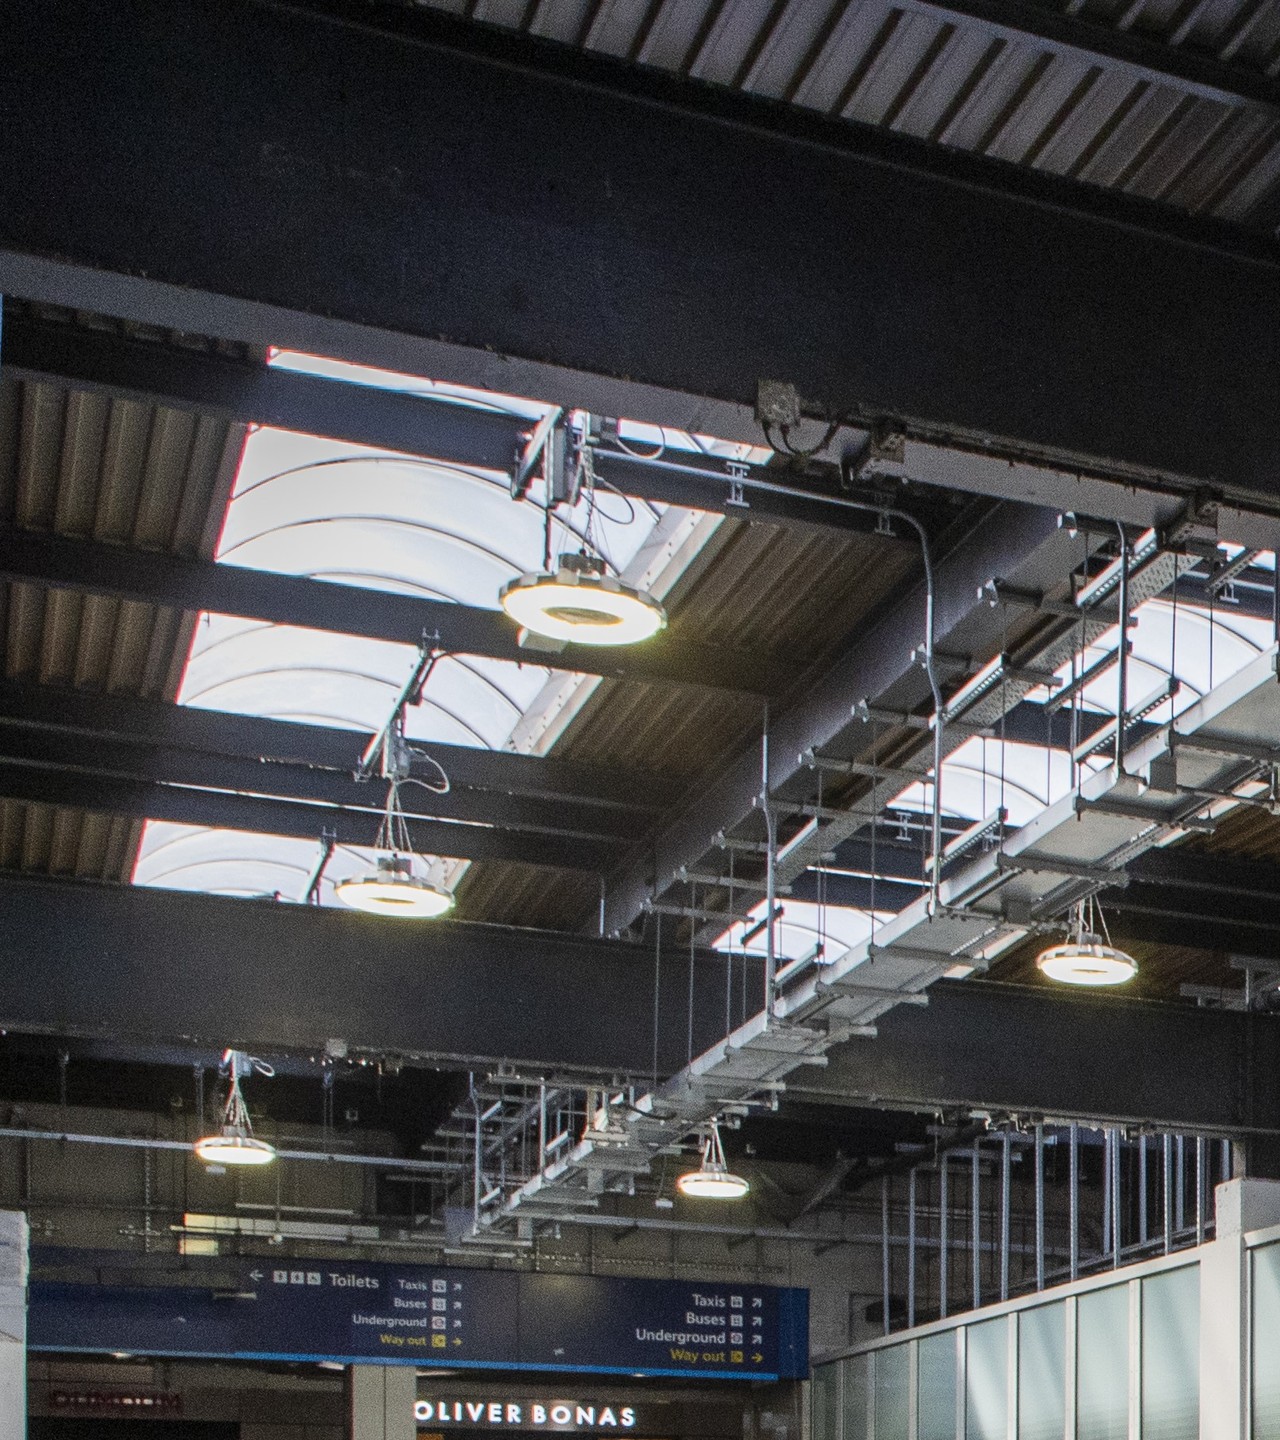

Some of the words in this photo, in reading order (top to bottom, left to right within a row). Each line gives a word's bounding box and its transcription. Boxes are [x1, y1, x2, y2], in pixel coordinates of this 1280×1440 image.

[329, 1273, 380, 1288] Toilets
[398, 1279, 427, 1291] Taxis
[393, 1297, 427, 1309] Buses
[692, 1293, 726, 1307] Taxis
[353, 1314, 427, 1328] Underground
[686, 1312, 726, 1325] Buses
[379, 1333, 404, 1346] Way
[407, 1336, 426, 1346] out
[635, 1328, 726, 1345] Underground
[670, 1348, 699, 1364] Way
[702, 1351, 726, 1362] out
[414, 1400, 522, 1424] OLIVER
[532, 1404, 636, 1427] BONAS
